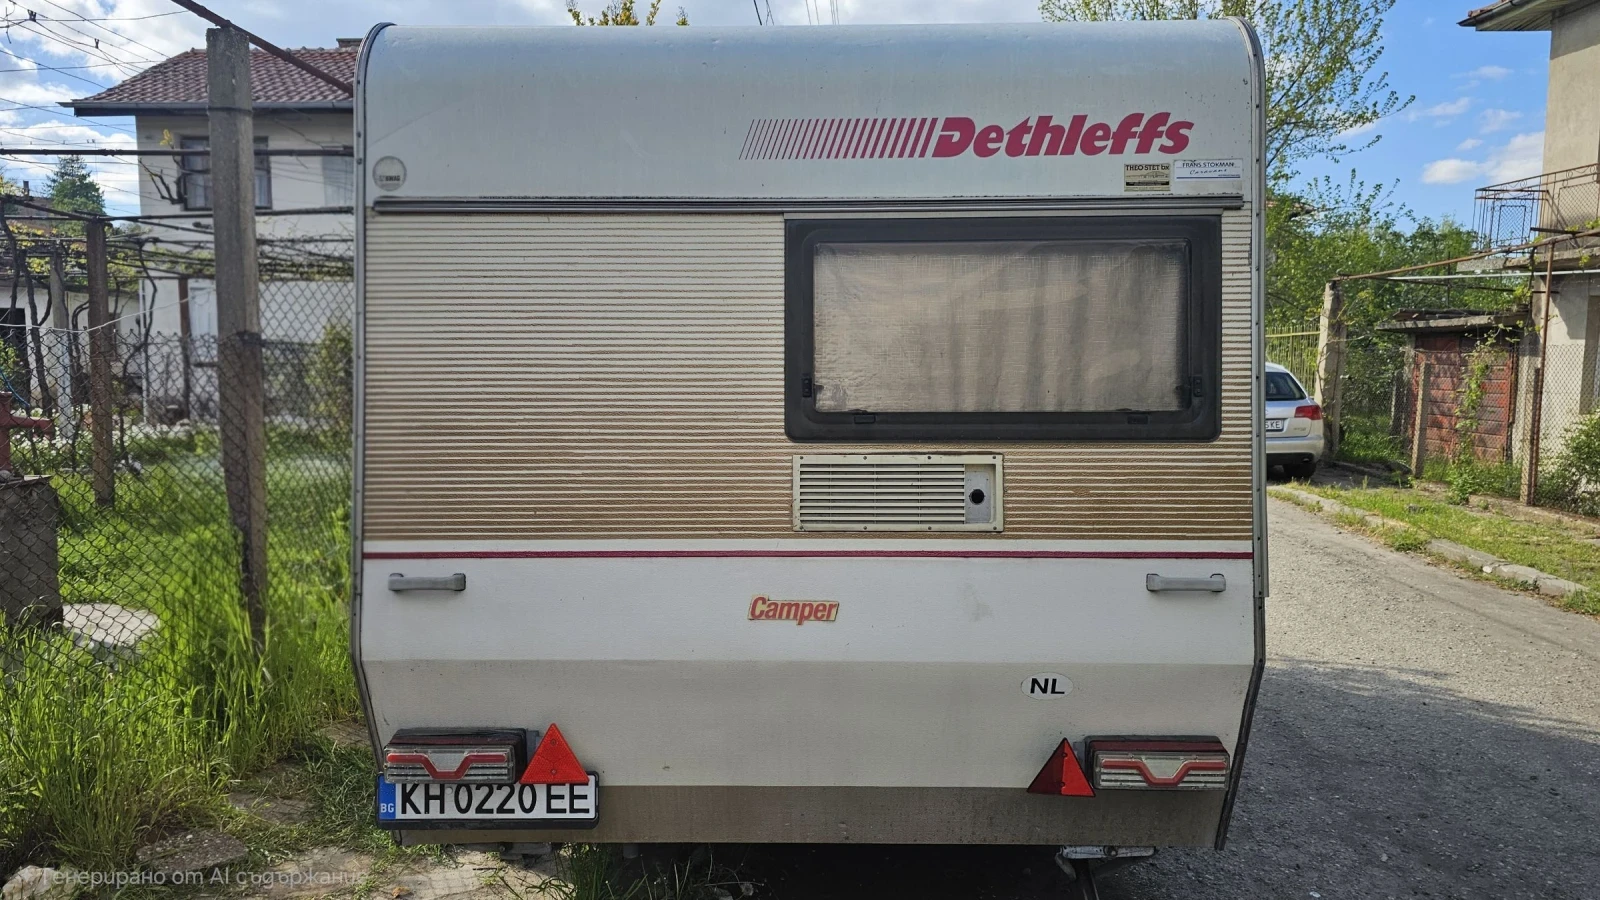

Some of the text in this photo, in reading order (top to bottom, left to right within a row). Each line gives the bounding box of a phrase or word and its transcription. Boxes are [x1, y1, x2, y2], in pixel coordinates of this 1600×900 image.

[932, 112, 1194, 157] Dethleffs
[750, 596, 838, 625] Camper
[1030, 677, 1065, 694] NL
[380, 802, 394, 813] BG
[401, 783, 590, 814] KH 0220 EE
